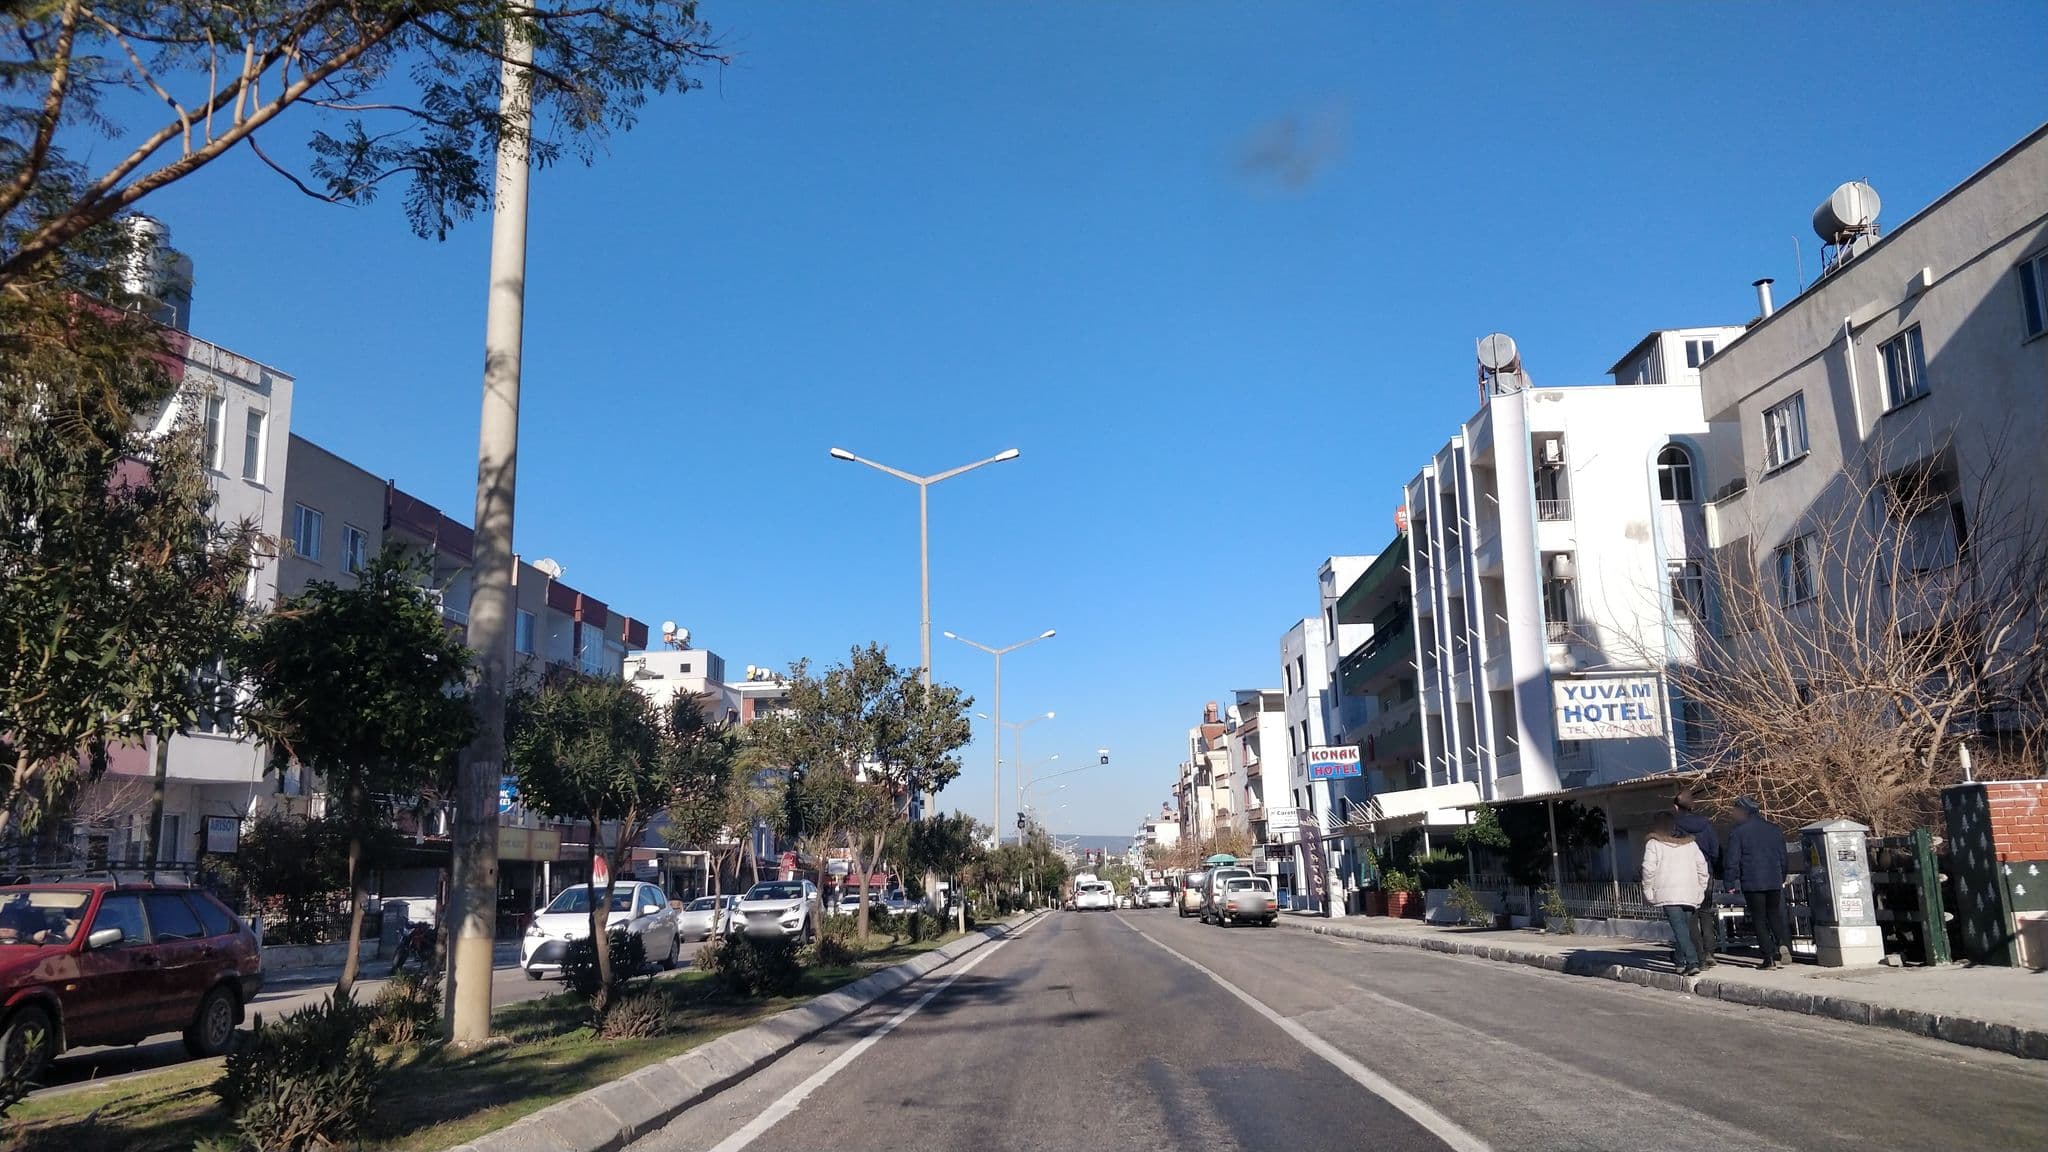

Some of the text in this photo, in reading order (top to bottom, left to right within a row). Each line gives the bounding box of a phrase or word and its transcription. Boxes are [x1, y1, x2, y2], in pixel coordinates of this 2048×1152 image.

[1562, 684, 1651, 700] YUVAM
[1563, 703, 1653, 722] HOTEL
[1311, 749, 1357, 760] KONAK
[1314, 763, 1357, 775] HOTEL
